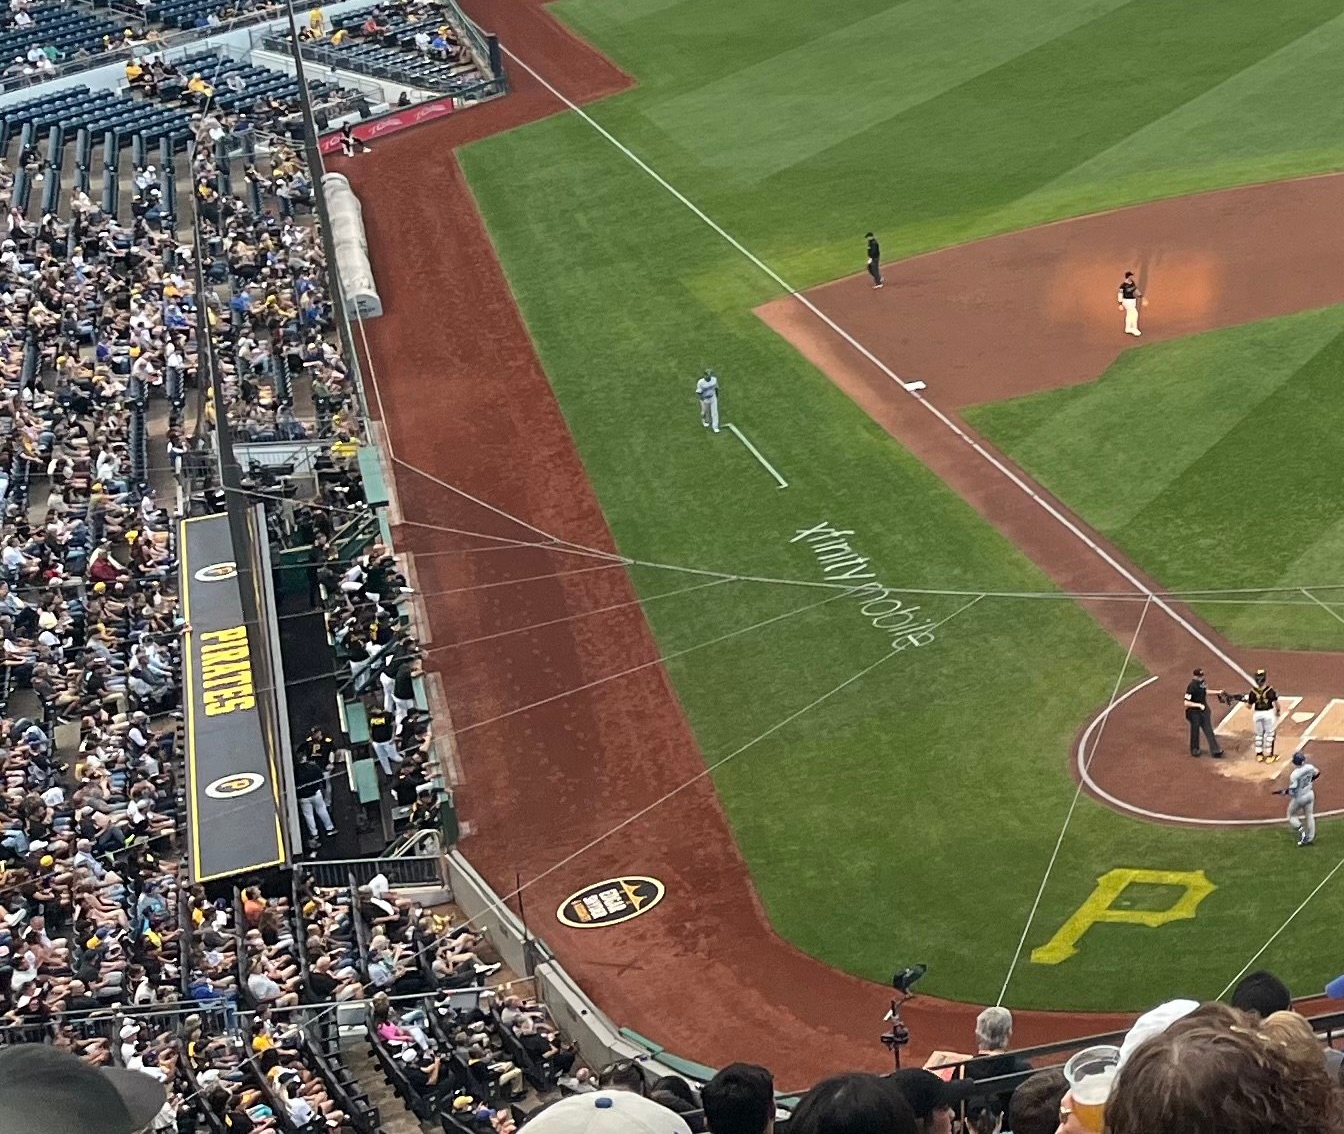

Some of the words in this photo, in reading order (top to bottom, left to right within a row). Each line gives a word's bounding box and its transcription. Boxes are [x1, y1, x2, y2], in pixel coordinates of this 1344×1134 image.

[790, 521, 877, 581] xfinity
[200, 624, 256, 716] PIRATES
[1030, 867, 1217, 964] P
